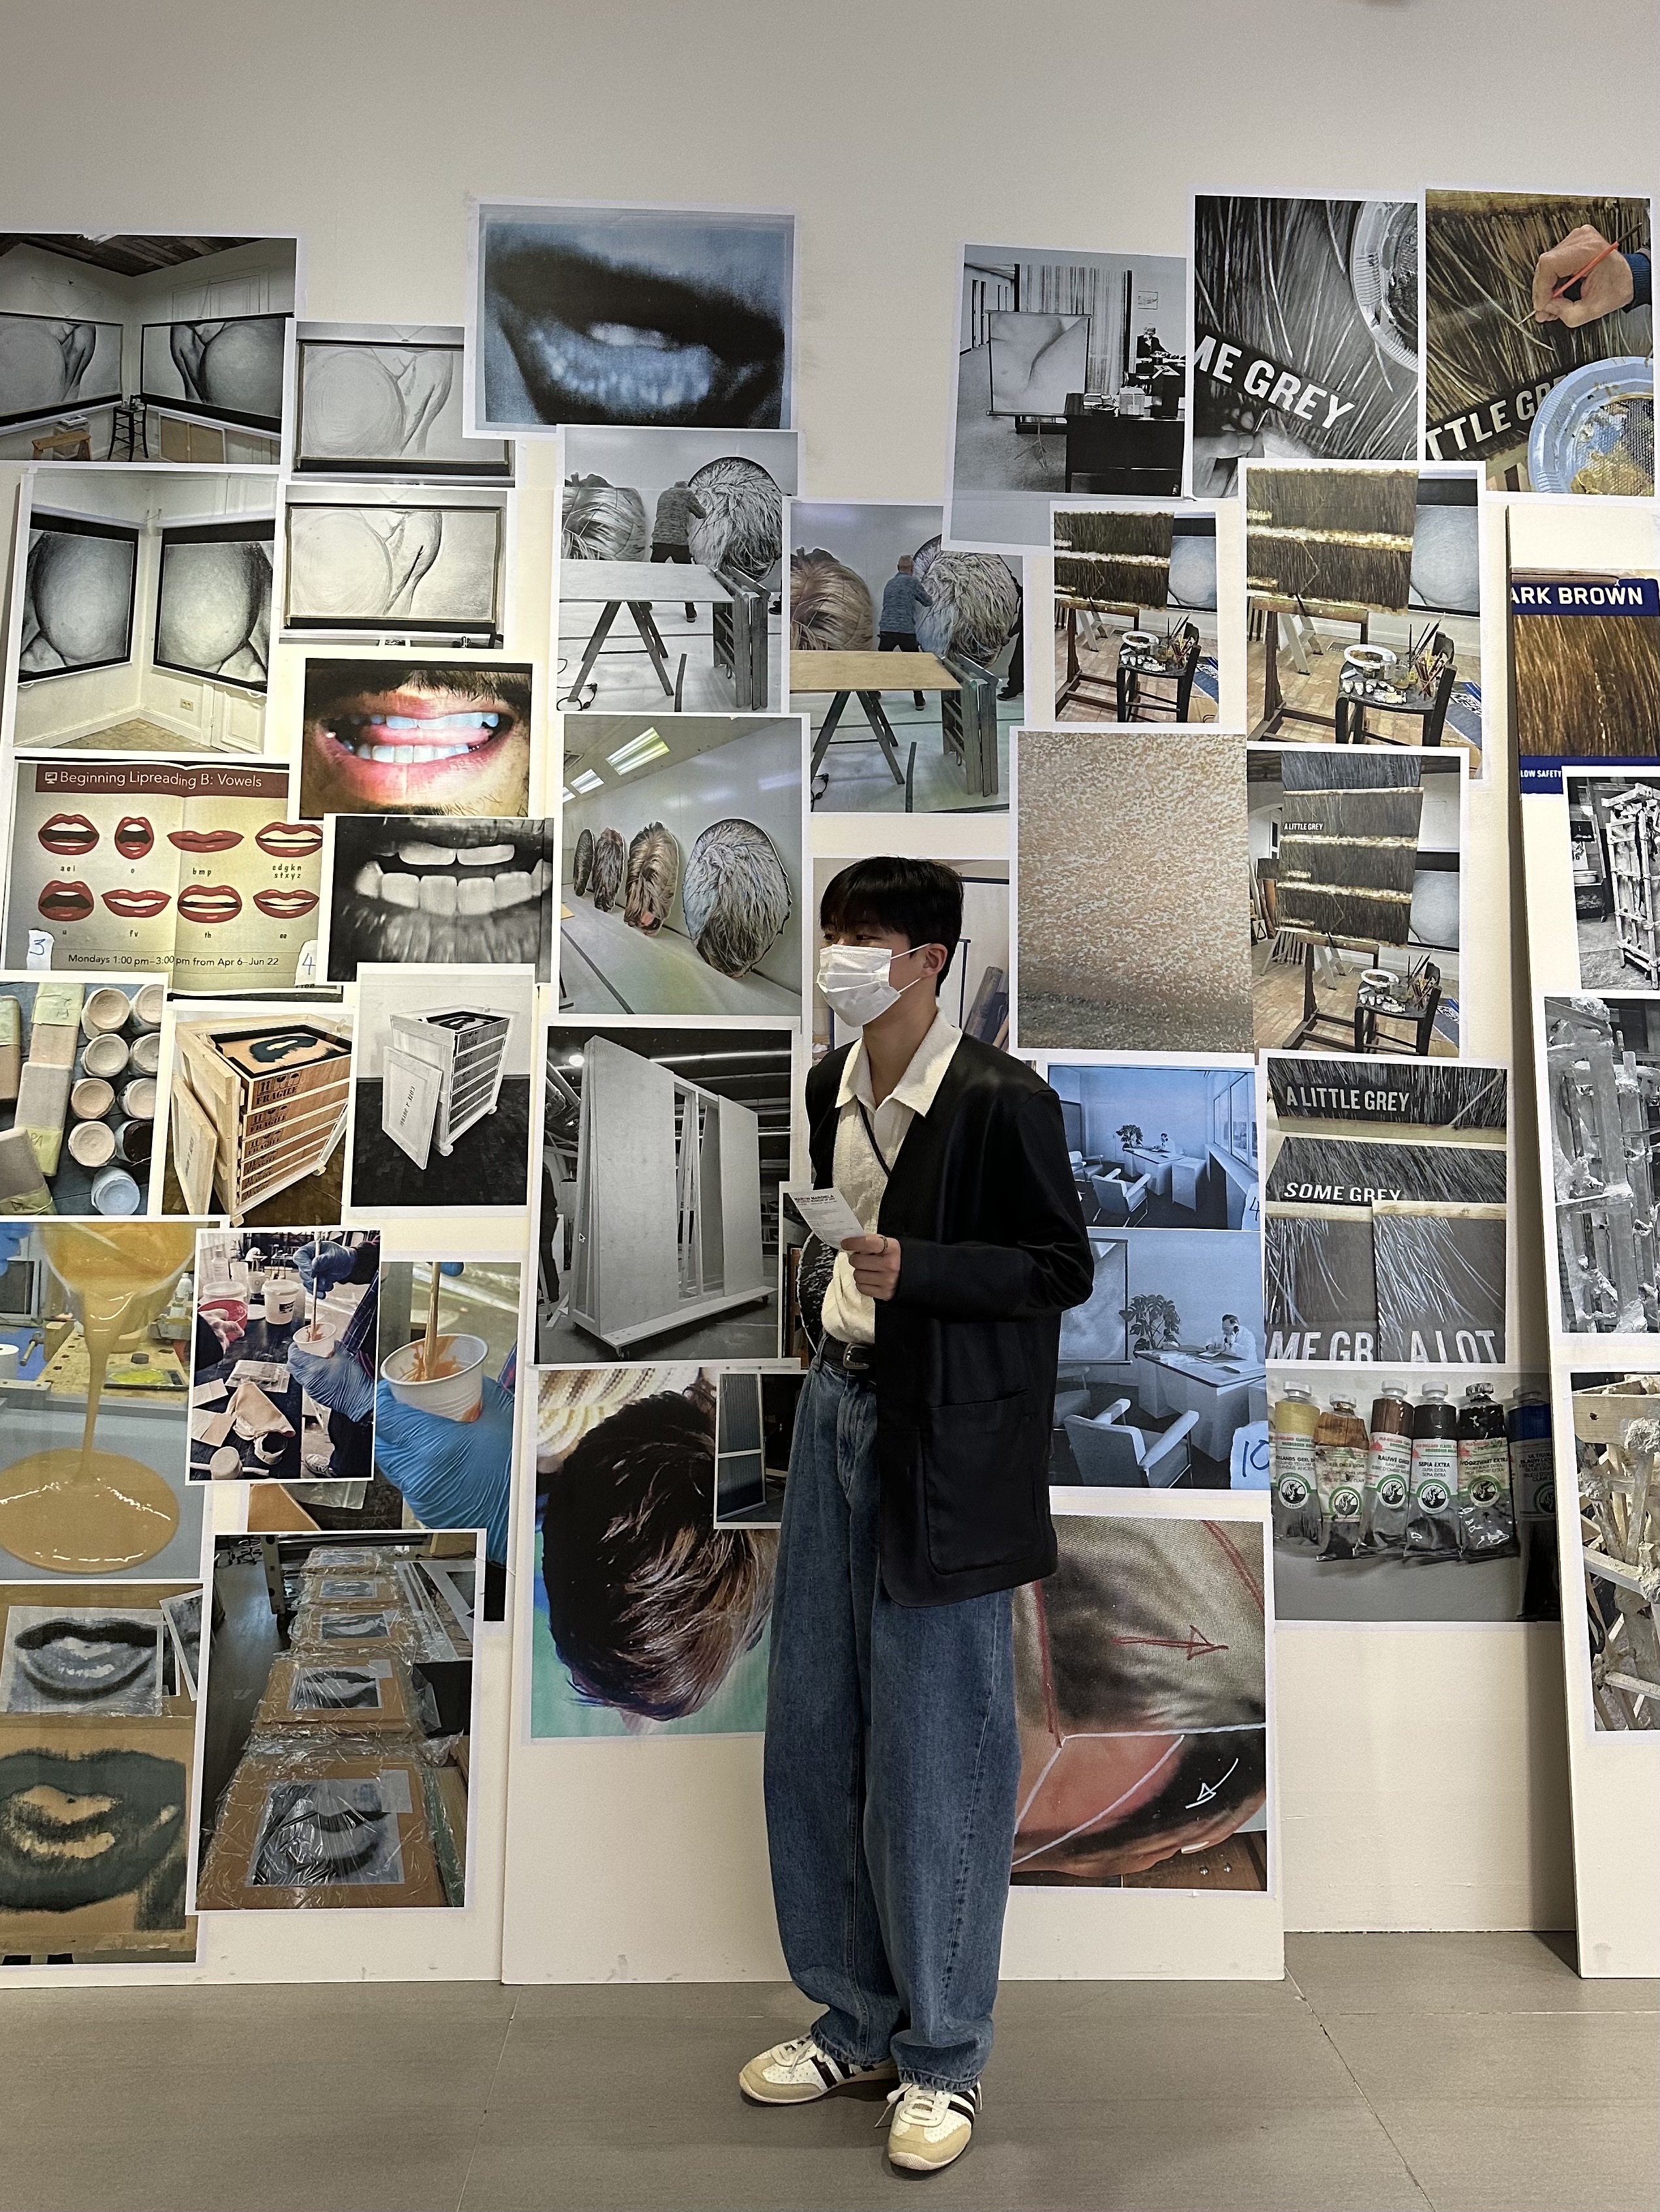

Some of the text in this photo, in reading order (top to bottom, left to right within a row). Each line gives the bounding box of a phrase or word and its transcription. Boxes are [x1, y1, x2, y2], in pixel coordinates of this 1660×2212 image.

[1244, 360, 1355, 429] GREY
[1426, 400, 1512, 461] TTLE
[1511, 587, 1643, 605] ARK BROWN
[60, 771, 262, 790] Beginning Lipreading B: Vowels
[29, 938, 46, 955] 3
[68, 954, 110, 965] Mondays
[113, 956, 132, 965] 1:00
[176, 958, 190, 967] pm
[193, 957, 215, 966] from
[217, 958, 235, 968] Apr
[302, 953, 316, 975] 4
[256, 1086, 298, 1105] FRAGILE
[1287, 1086, 1409, 1112] A LITTLE GREY
[250, 1114, 287, 1133] FRAGILE
[1284, 1182, 1402, 1202] SOME GREY
[1249, 1196, 1260, 1221] 4
[1410, 1330, 1430, 1362] A
[1242, 1439, 1270, 1477] 10
